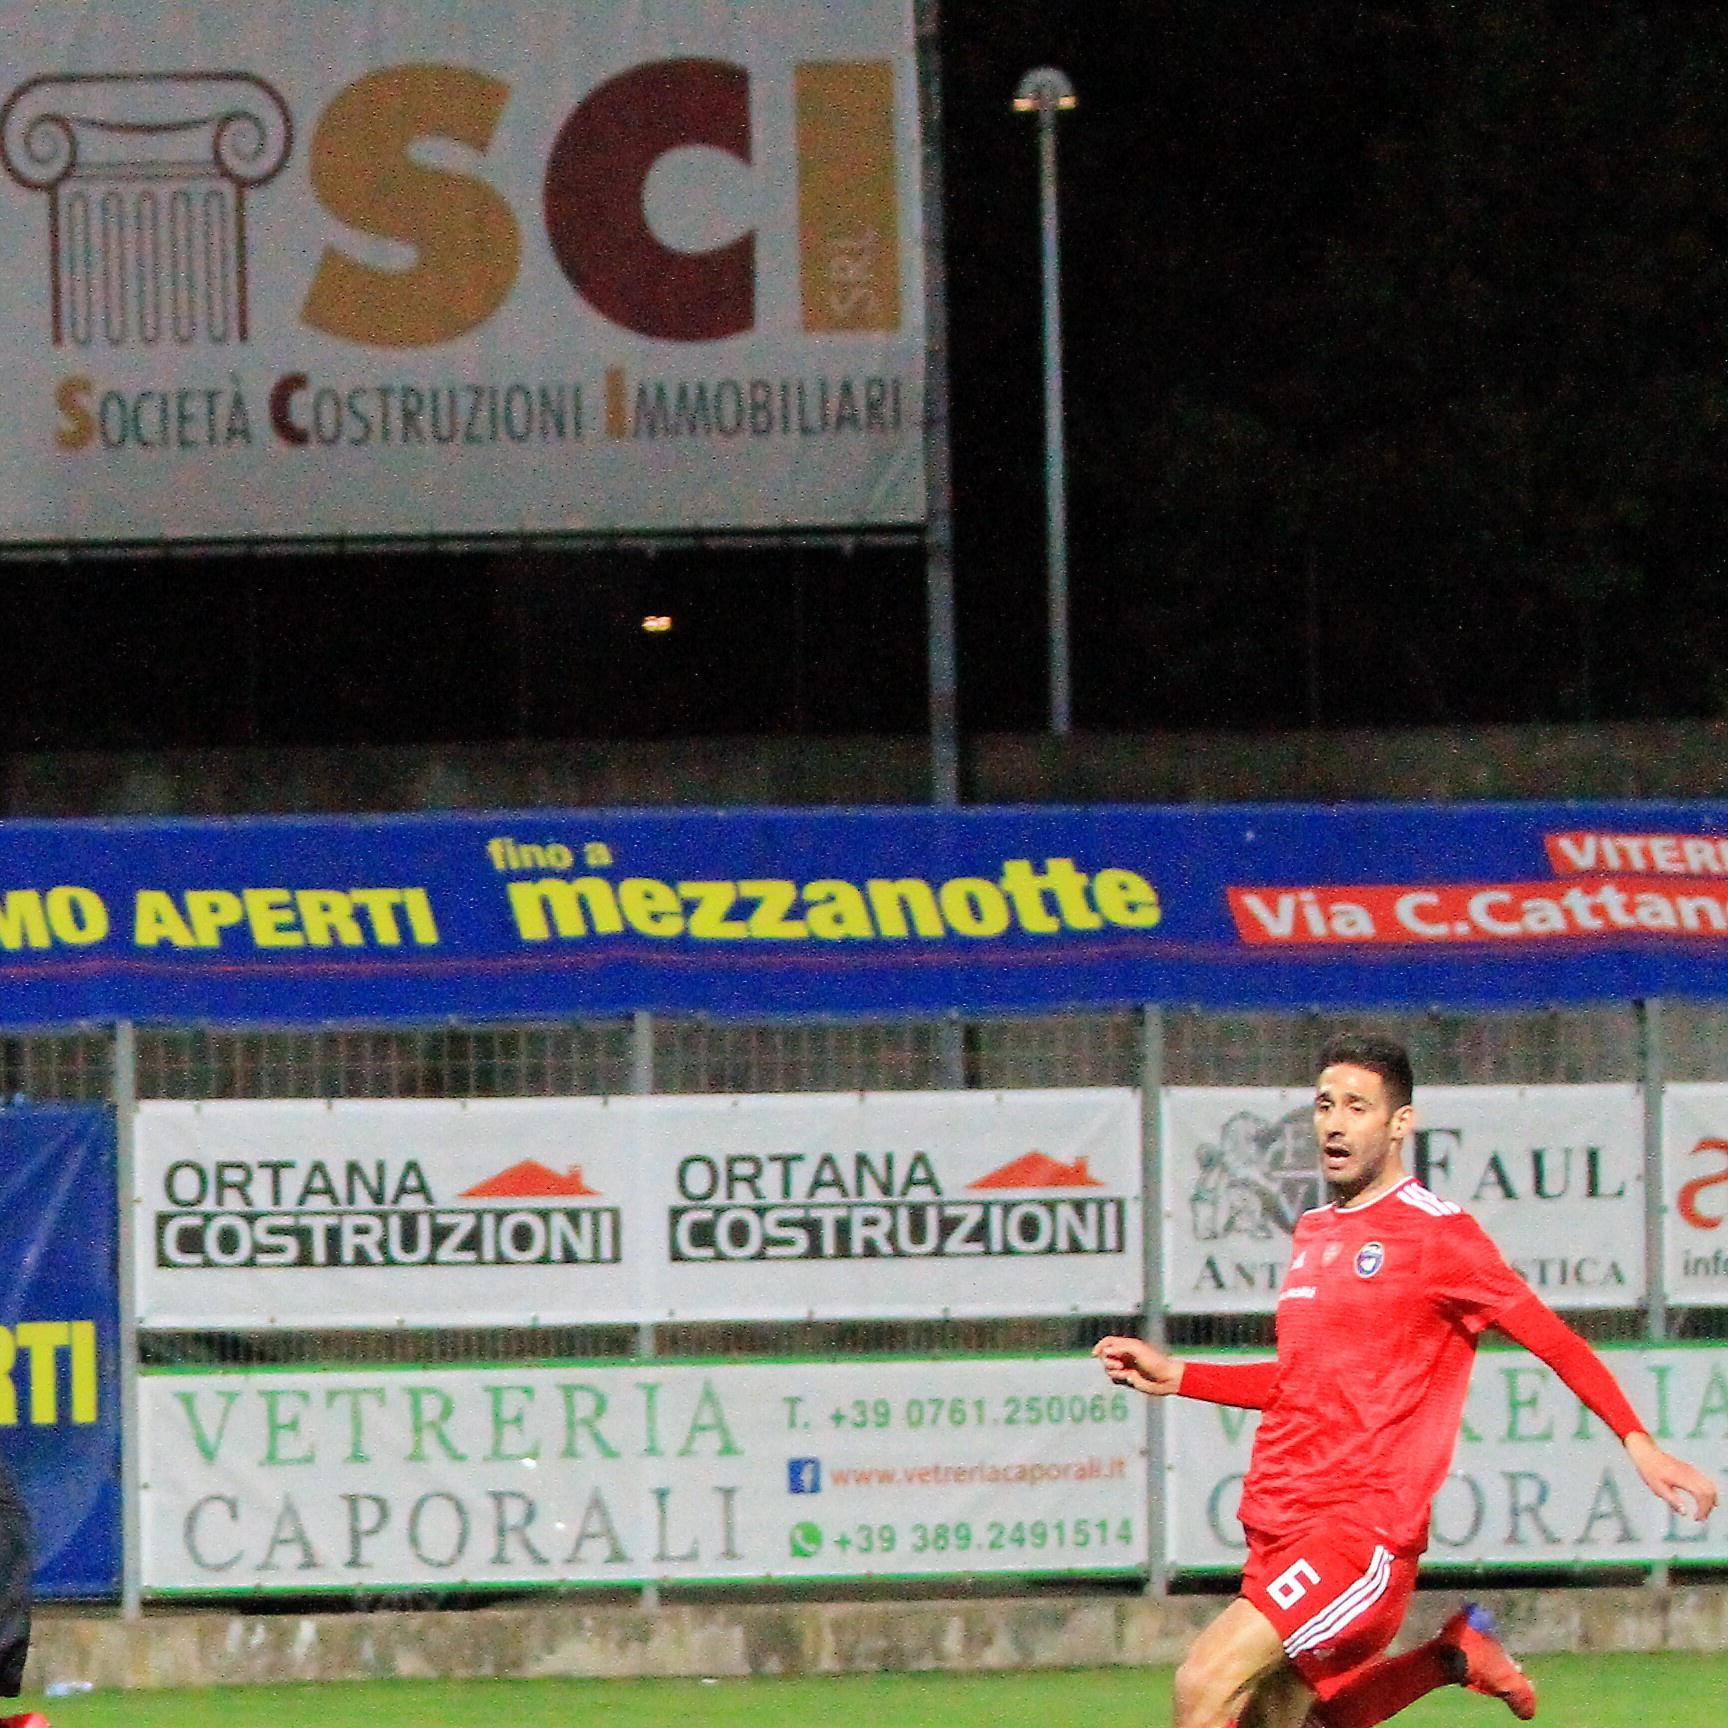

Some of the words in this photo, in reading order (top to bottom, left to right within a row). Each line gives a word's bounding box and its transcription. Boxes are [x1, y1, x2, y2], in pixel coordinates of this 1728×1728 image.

[300, 56, 903, 348] SCI
[54, 371, 253, 451] SOCIETÀ
[269, 372, 585, 448] COSTRUZIONI
[604, 364, 903, 441] IMMOBILIARI
[487, 837, 574, 872] fino
[584, 840, 613, 867] a
[134, 887, 439, 949] APERTI
[507, 856, 1162, 942] mezzanotte
[1242, 891, 1376, 938] Via
[163, 1158, 436, 1208] ORTANA
[677, 1150, 944, 1201] ORTANA
[1413, 1127, 1627, 1201] FAUL
[160, 1211, 616, 1265] COSTRUZIONI
[674, 1202, 1122, 1260] COSTRUZIONI
[175, 1378, 744, 1466] VETRERIA
[831, 1397, 892, 1429] +39
[905, 1391, 1129, 1428] 0761.250066
[183, 1483, 744, 1572] CAPORALI
[834, 1522, 896, 1552] +39
[911, 1517, 1134, 1551] 389.2491514
[1266, 1558, 1322, 1611] 6
